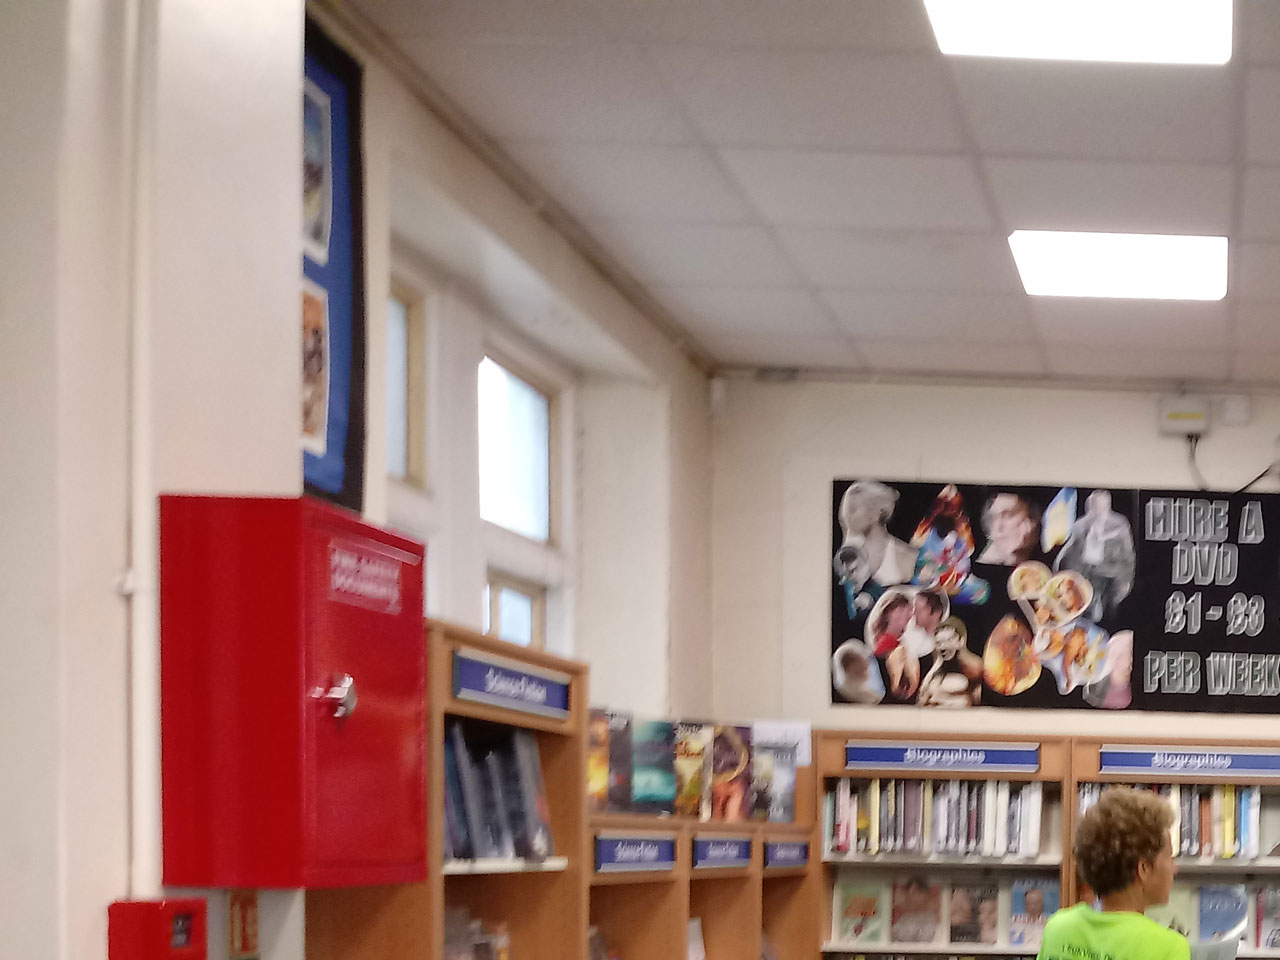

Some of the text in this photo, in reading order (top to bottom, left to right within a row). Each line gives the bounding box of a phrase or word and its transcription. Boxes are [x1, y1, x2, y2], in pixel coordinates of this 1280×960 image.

[1145, 497, 1265, 544] HIRE A
[1171, 541, 1239, 586] DVD
[1143, 650, 1201, 694] PER
[904, 747, 986, 766] Biographies
[1152, 752, 1232, 770] Biographies
